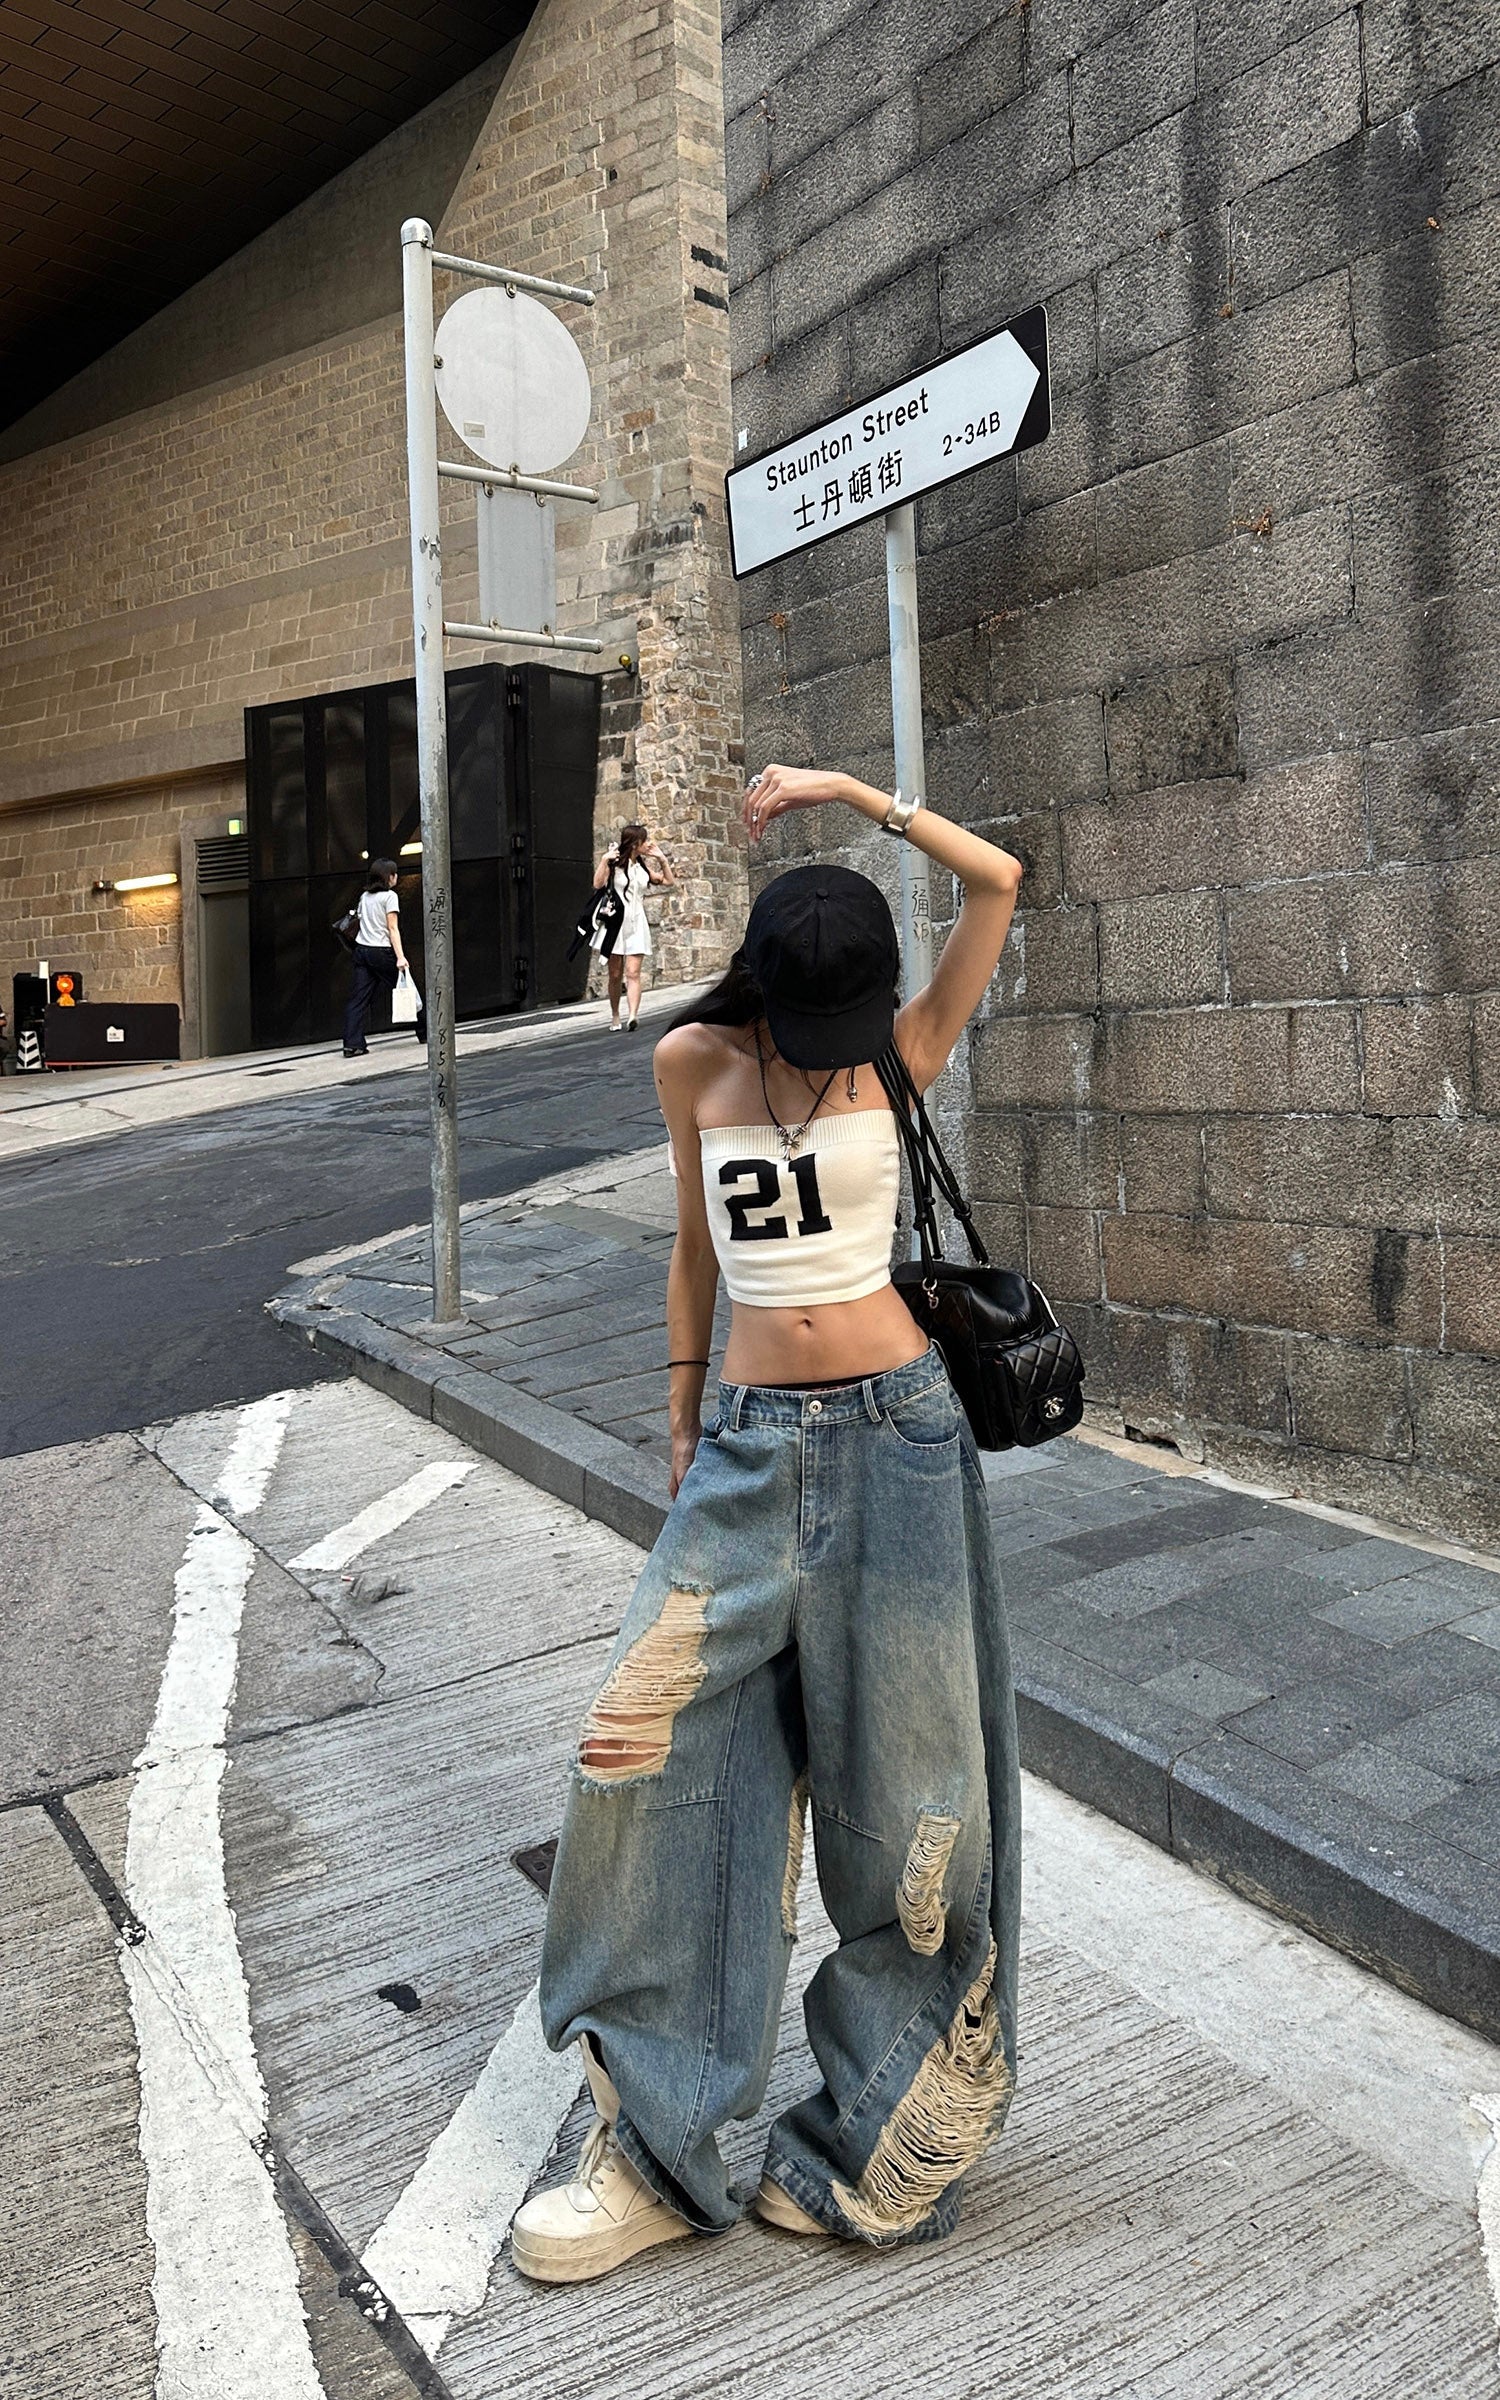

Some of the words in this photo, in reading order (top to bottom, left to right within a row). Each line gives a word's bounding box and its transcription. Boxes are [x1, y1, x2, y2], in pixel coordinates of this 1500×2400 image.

[767, 434, 853, 492] Staunton
[863, 387, 930, 443] Street
[793, 450, 903, 532] 士丹頓街
[719, 1152, 833, 1241] 21
